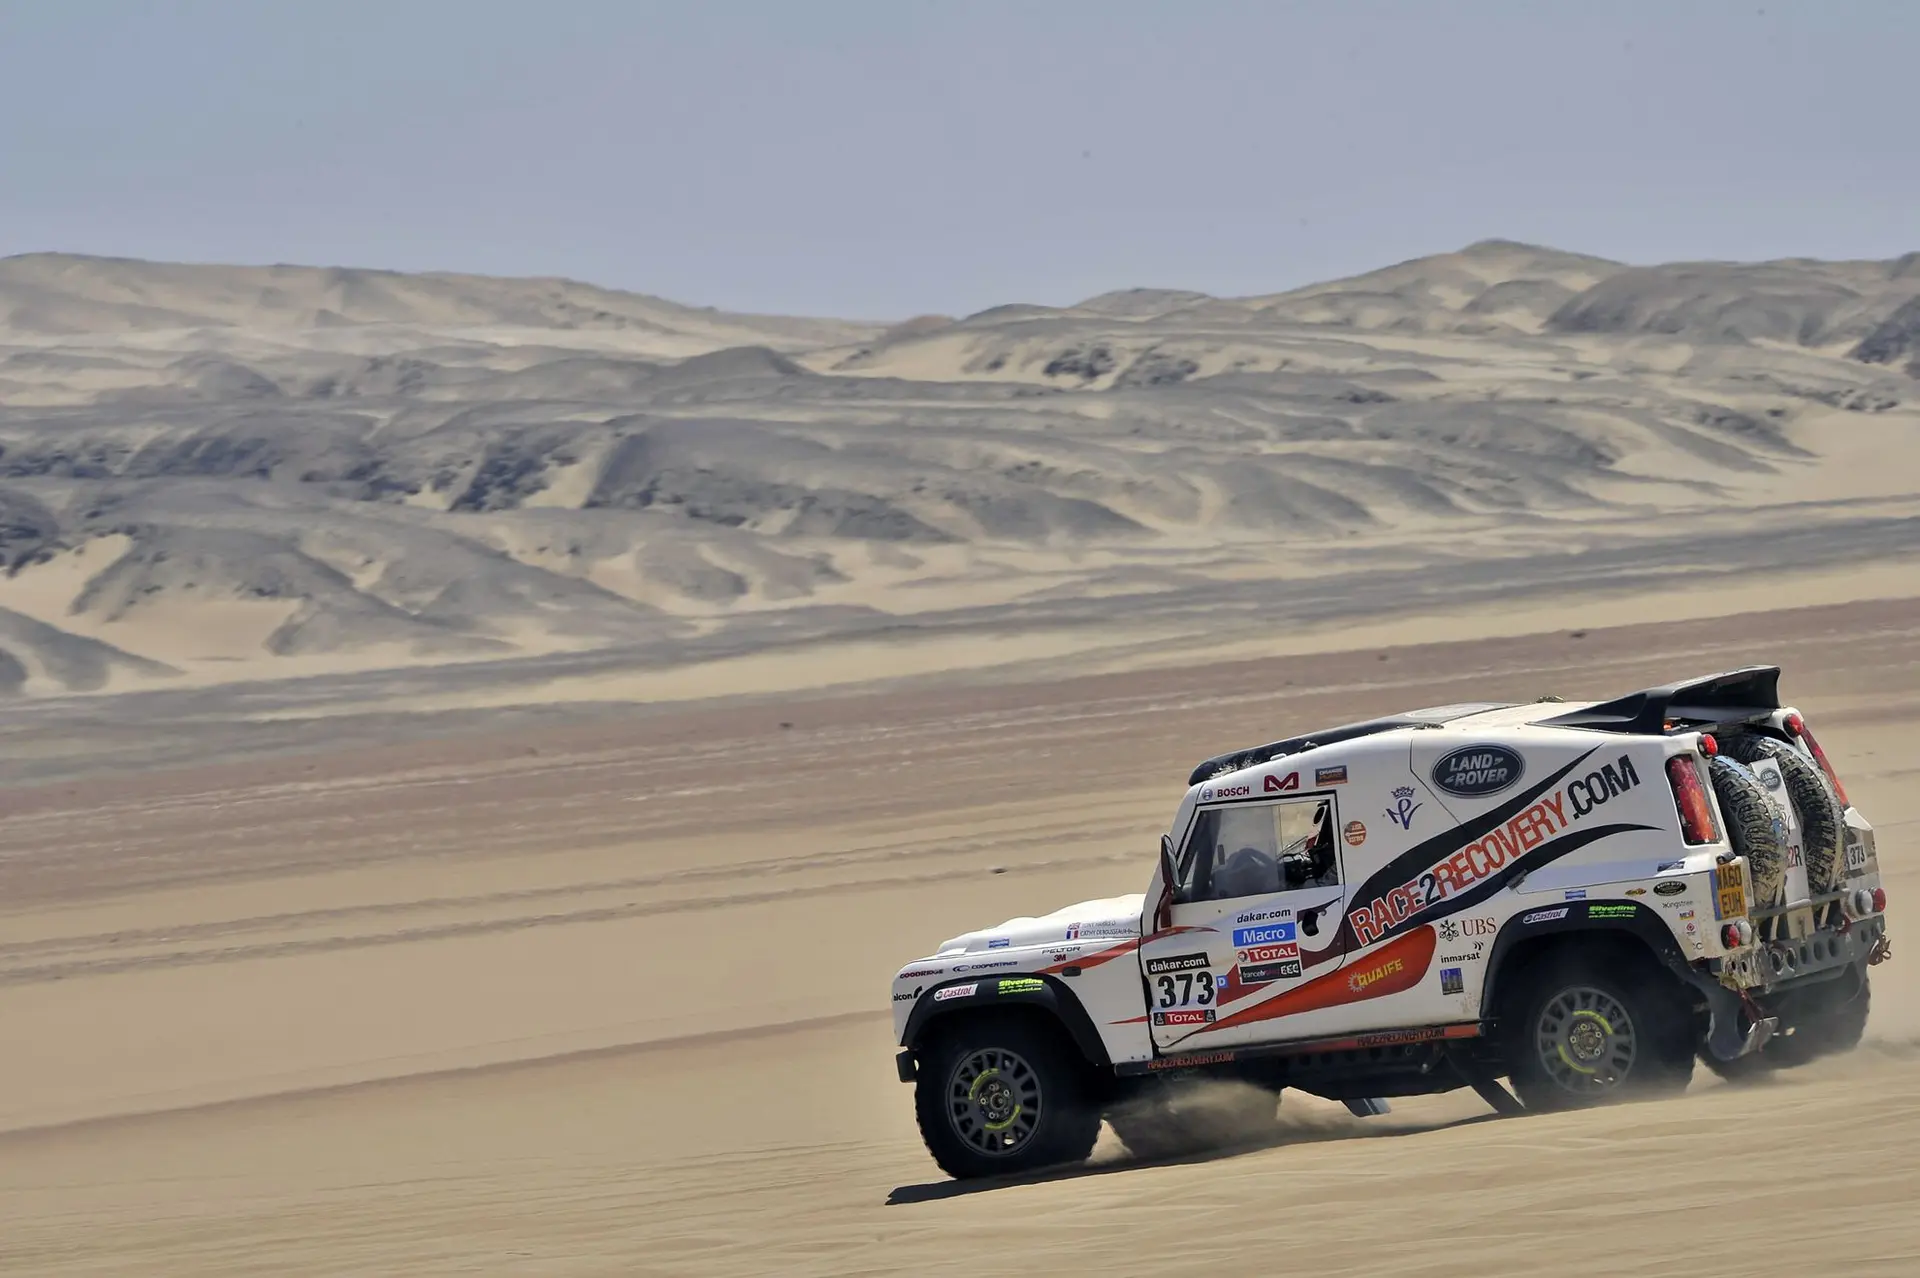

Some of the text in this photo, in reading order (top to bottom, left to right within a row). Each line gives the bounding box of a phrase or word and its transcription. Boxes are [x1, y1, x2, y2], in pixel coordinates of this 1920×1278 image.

[1450, 753, 1492, 772] LAND
[1454, 768, 1508, 787] ROVER
[1217, 786, 1250, 797] BOSCH
[1350, 754, 1640, 947] RACE2RECOVERY.COM
[1236, 908, 1291, 923] dakar.com
[1532, 909, 1562, 922] Castrol
[1460, 917, 1497, 937] UBS
[1243, 928, 1286, 943] Macro
[1042, 946, 1081, 954] PELTOR
[1250, 947, 1297, 960] TOTAL
[1053, 954, 1067, 962] 3M
[1440, 951, 1480, 963] inmarsat
[1150, 957, 1206, 972] dakar.com
[900, 968, 944, 979] GOODRIDGE
[1357, 958, 1404, 986] QUAIFE
[998, 977, 1044, 987] Silverline
[1218, 977, 1226, 987] D
[942, 986, 972, 999] Castrol
[1157, 971, 1215, 1008] 373
[1167, 1013, 1203, 1023] TOTAL
